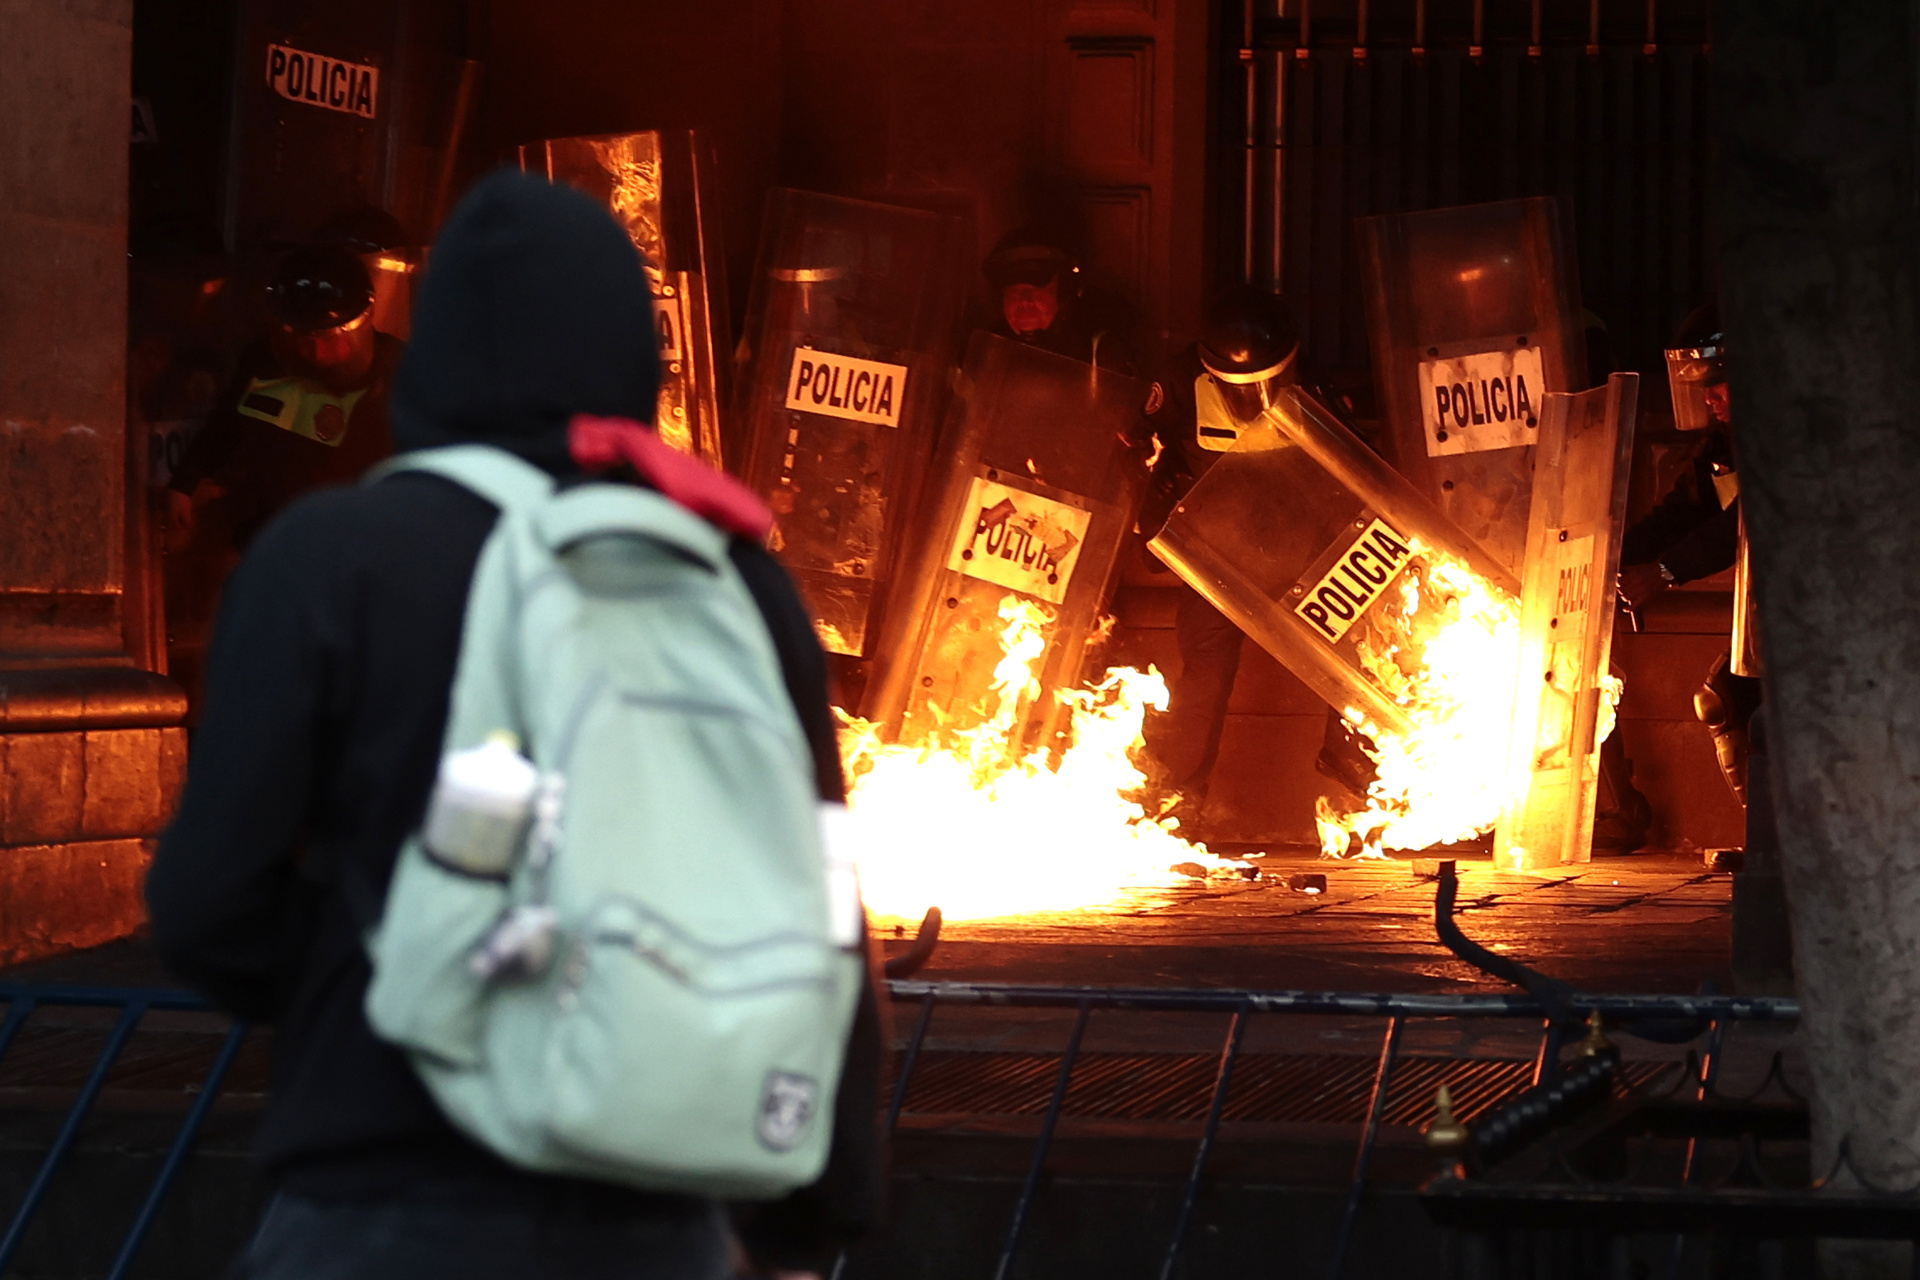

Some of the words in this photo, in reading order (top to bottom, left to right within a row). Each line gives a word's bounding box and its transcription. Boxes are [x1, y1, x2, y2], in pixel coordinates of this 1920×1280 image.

[271, 49, 371, 114] POLICIA
[795, 360, 893, 417] POLICIA
[1436, 374, 1533, 430] POLICIA
[1301, 529, 1410, 638] POLICIA
[1555, 563, 1592, 615] POLICI
